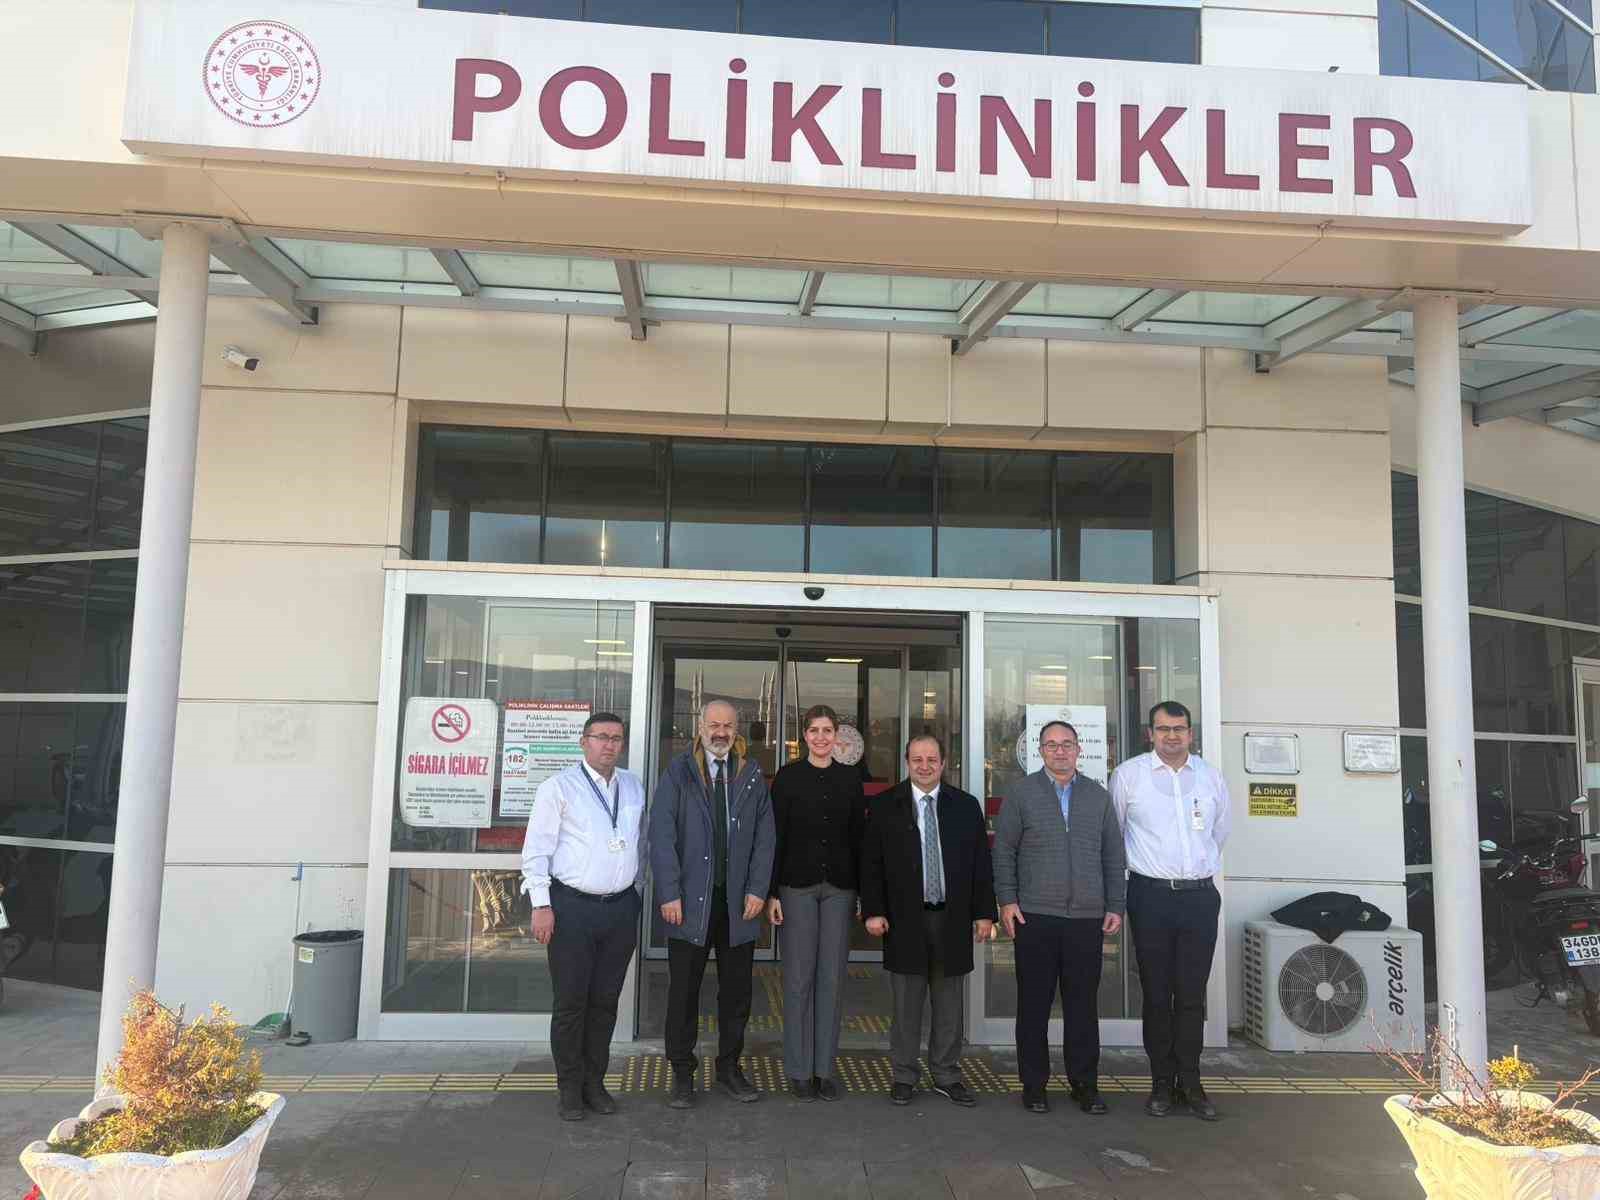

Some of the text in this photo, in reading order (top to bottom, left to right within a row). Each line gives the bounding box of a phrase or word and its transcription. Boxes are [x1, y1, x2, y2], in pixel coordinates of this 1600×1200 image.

[452, 57, 1418, 198] POLİKLİNİKLER
[407, 751, 489, 778] SİGARA İÇİLMEZ
[1263, 786, 1293, 796] DİKKAT
[1383, 940, 1406, 1016] arçelik
